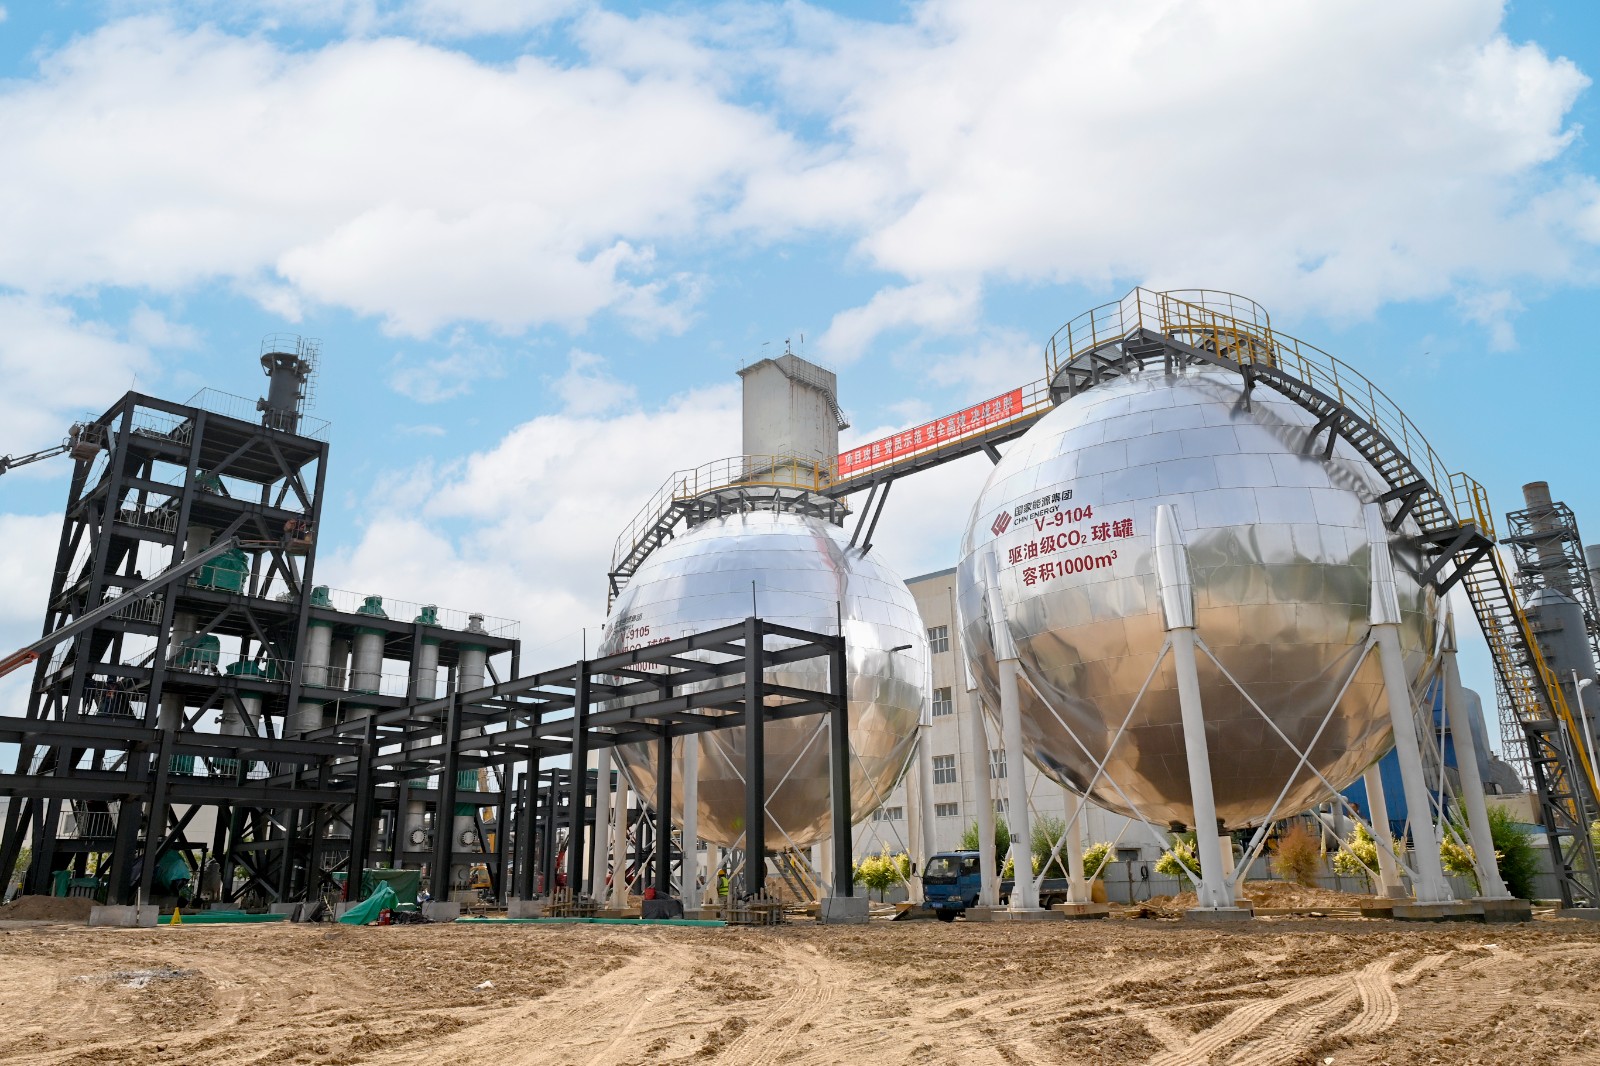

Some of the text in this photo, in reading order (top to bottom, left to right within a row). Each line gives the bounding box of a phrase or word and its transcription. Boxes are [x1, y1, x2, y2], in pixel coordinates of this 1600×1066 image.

[845, 444, 881, 466] 项目攻坚
[884, 430, 922, 455] 党员示范
[926, 414, 966, 440] 安全高效
[971, 395, 1013, 423] 决战决胜
[1014, 489, 1073, 517] 国家能源集团
[1014, 505, 1060, 526] CHN ENERGY
[1035, 505, 1093, 532] V-9104
[621, 626, 650, 643] V-9105
